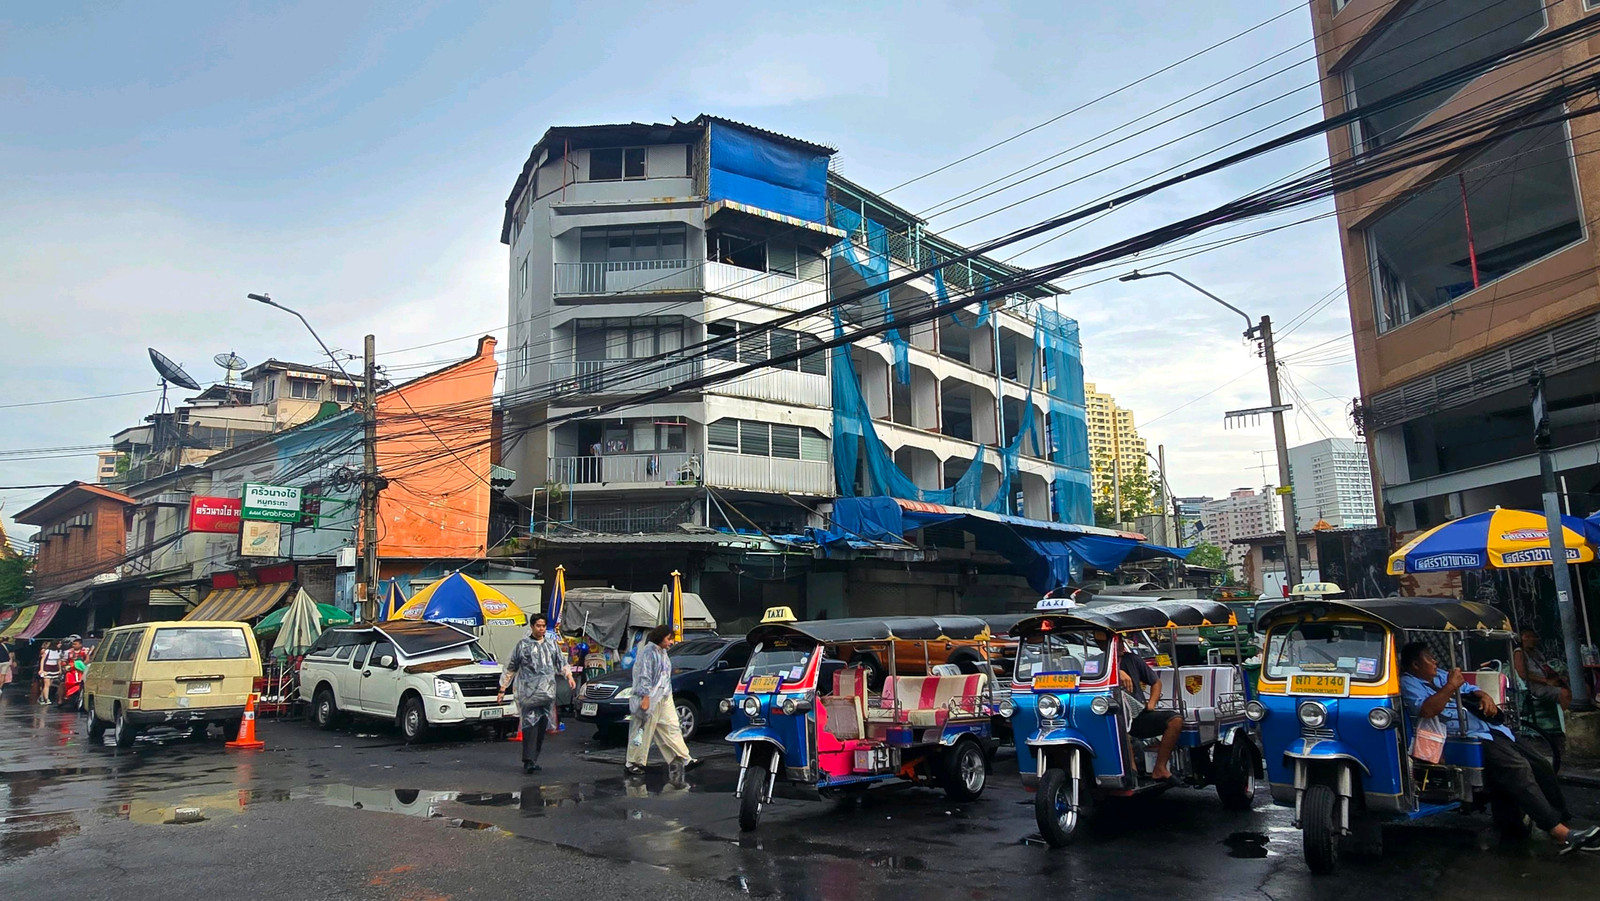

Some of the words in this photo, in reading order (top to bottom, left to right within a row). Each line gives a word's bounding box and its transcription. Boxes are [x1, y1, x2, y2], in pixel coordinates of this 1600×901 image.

[262, 510, 296, 518] GrabFood
[1298, 584, 1327, 592] TAXI
[767, 608, 784, 618] TAXI
[1316, 677, 1344, 686] 2140
